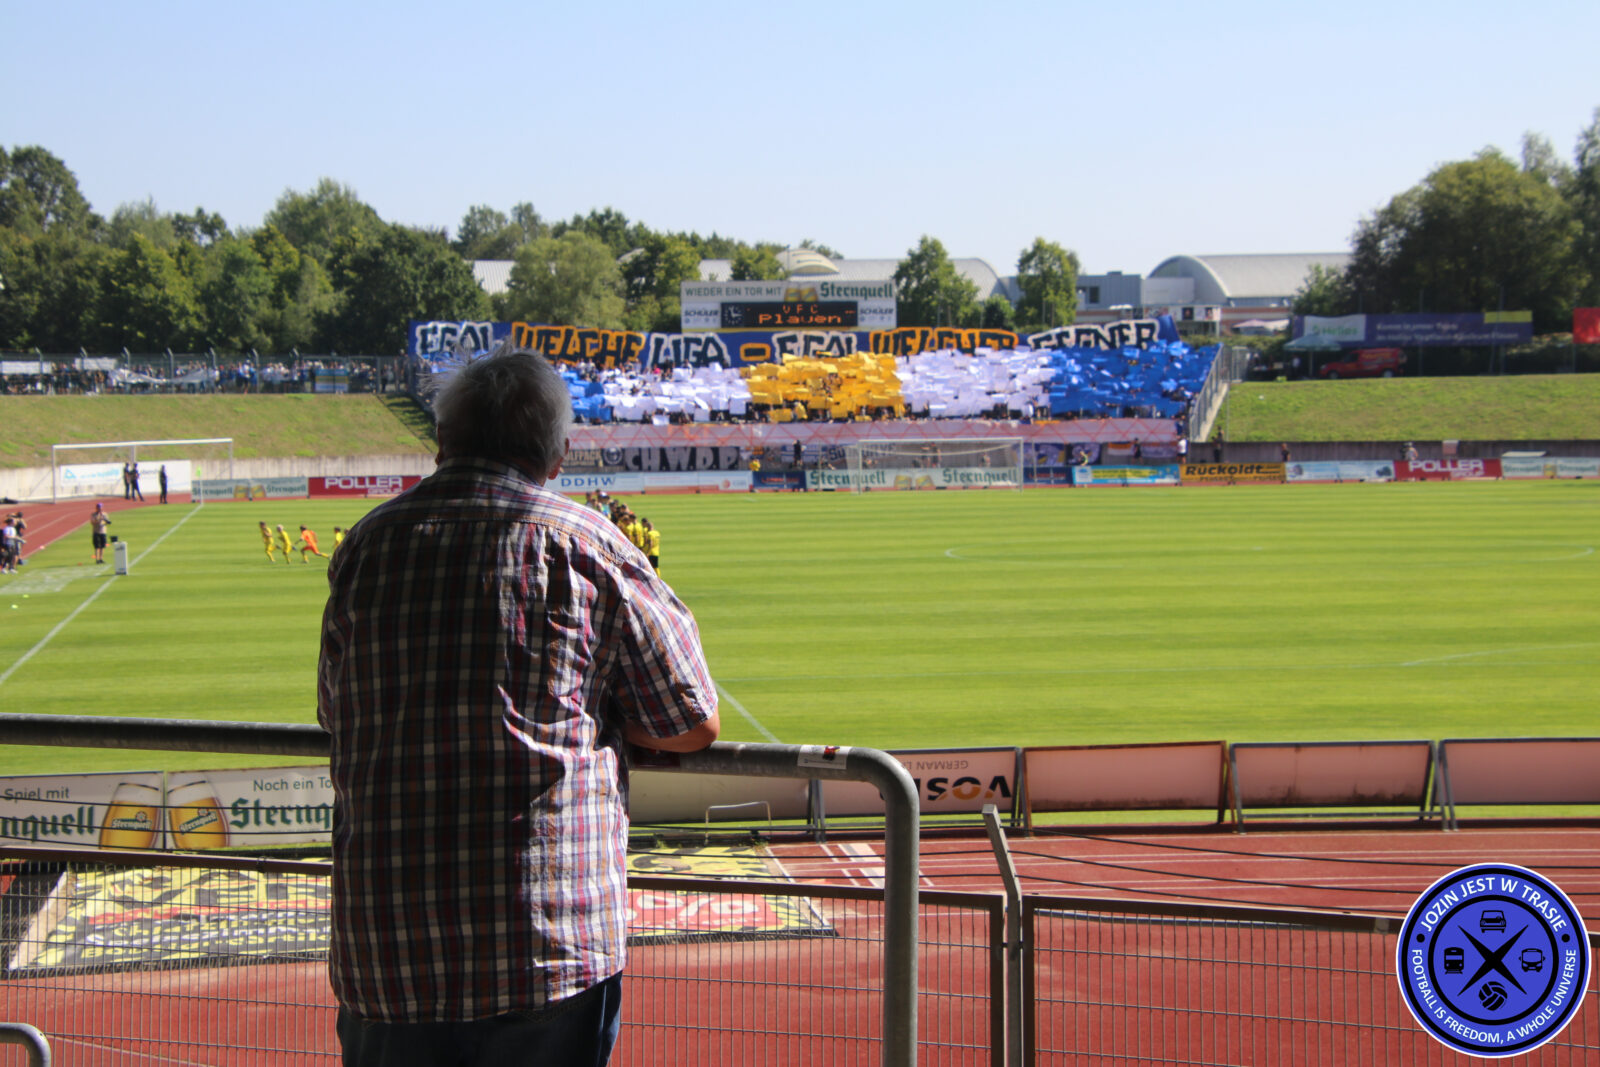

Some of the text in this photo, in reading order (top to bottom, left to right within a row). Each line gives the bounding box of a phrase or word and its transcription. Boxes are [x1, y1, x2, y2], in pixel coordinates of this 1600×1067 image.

[685, 282, 893, 300] WIEDER EIN TOR MIT Sternquell
[758, 314, 842, 324] Plauen
[650, 333, 731, 367] LIGA
[1409, 459, 1484, 472] POLLER
[561, 477, 616, 487] DDHW
[942, 467, 1019, 484] Sternquell
[325, 477, 403, 489] POLLER
[253, 779, 289, 791] Noch
[293, 780, 314, 790] ein
[4, 786, 70, 803] Spiel mit
